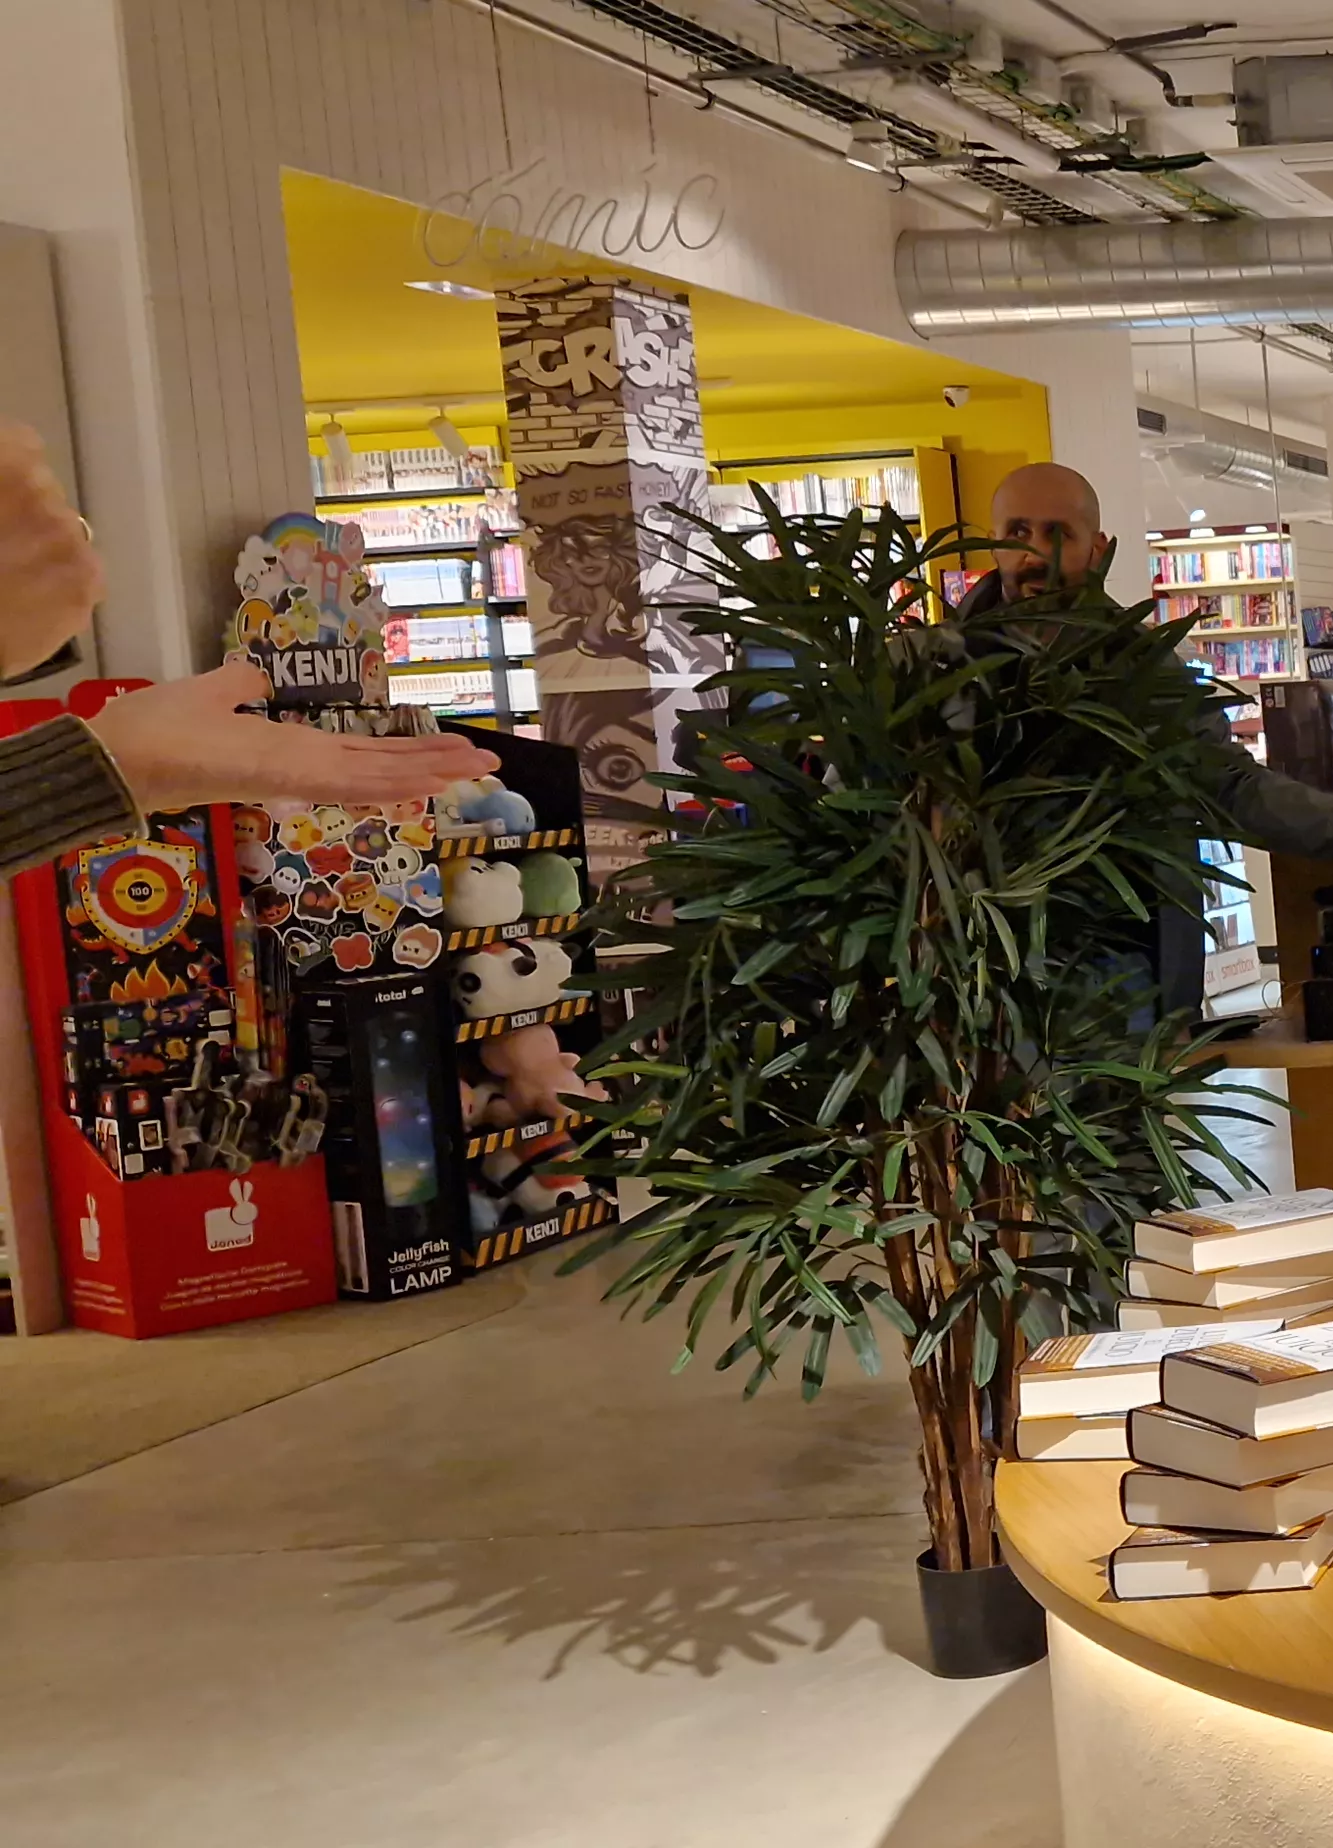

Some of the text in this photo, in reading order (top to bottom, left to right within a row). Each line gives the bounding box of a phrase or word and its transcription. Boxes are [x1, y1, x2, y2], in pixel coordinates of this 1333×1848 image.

[567, 489, 588, 505] SO
[272, 650, 358, 688] KENJI
[493, 834, 521, 850] KENJI
[131, 886, 150, 896] 100
[501, 922, 529, 940] KENJI
[511, 1011, 537, 1028] KENJI
[521, 1122, 548, 1140] KENJI
[525, 1218, 560, 1244] KENJI
[390, 1267, 452, 1294] LAMP
